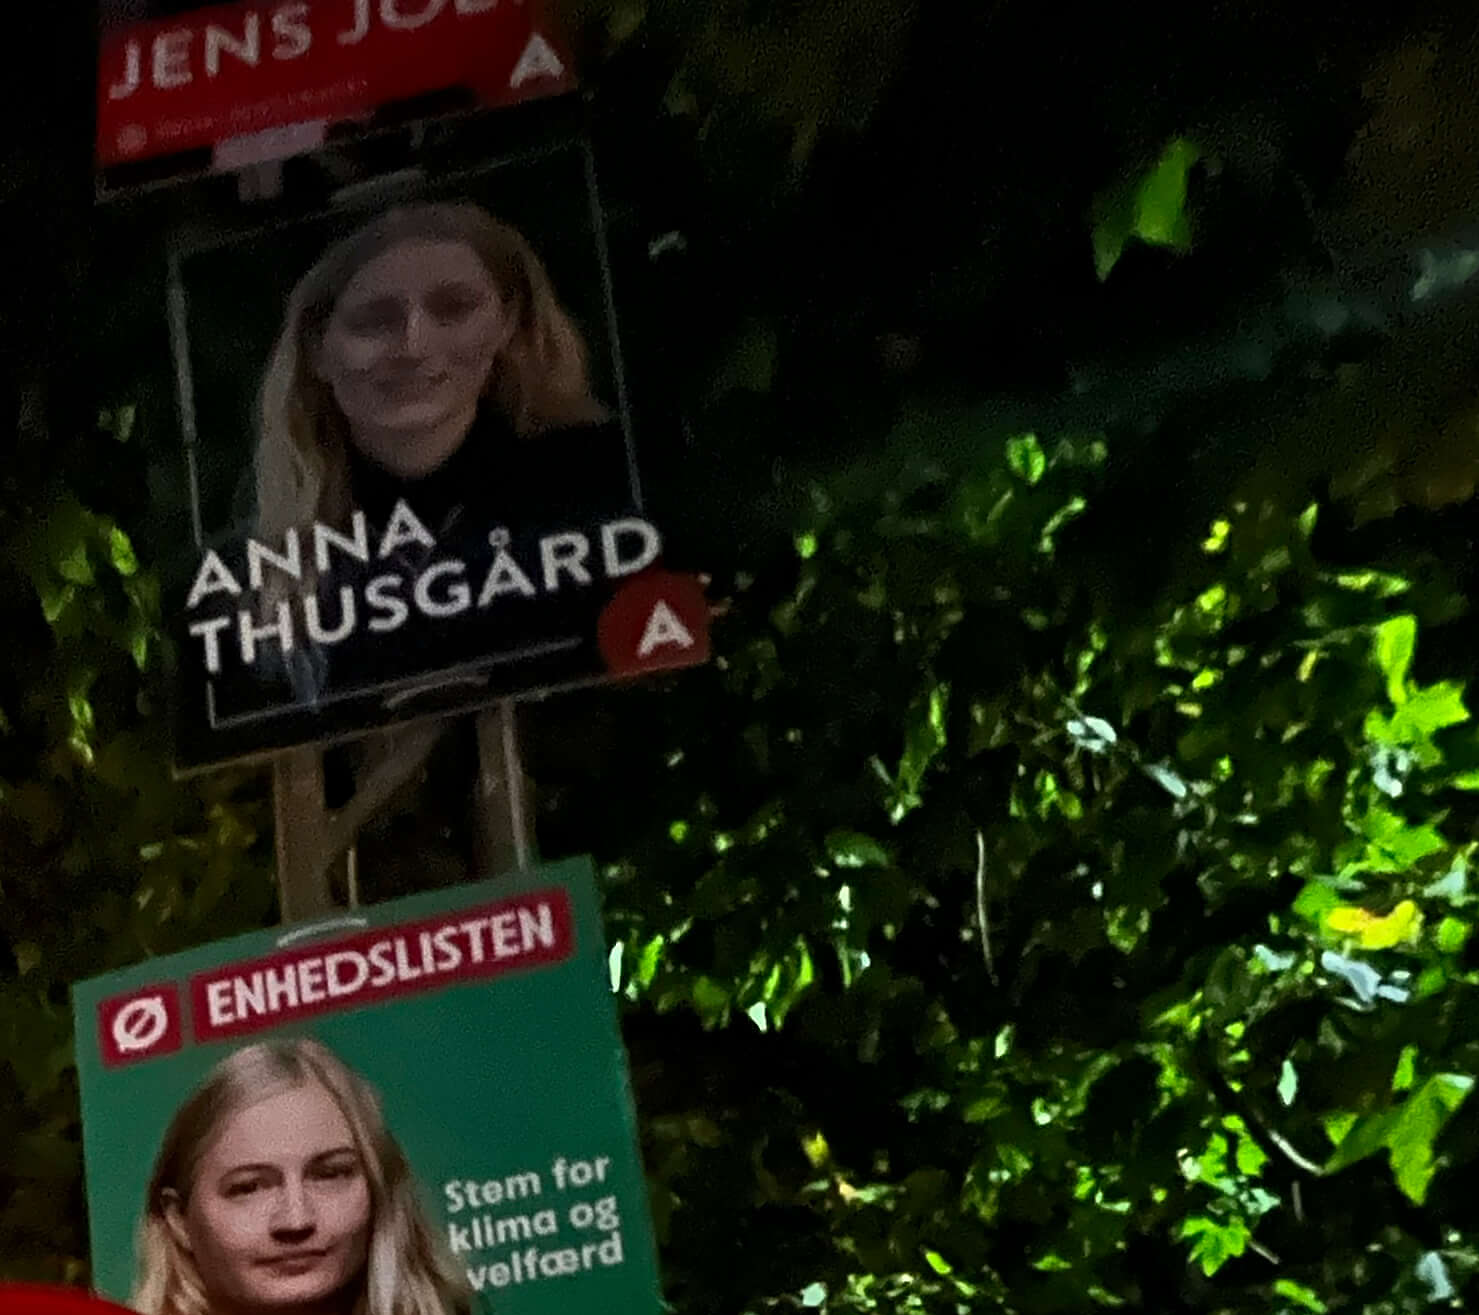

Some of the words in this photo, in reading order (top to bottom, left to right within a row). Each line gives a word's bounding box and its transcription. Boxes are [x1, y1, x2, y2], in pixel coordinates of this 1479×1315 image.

[108, 2, 313, 100] JENS
[509, 32, 565, 89] A
[186, 498, 436, 609] ANNA
[189, 517, 661, 673] THUSGÅRD
[638, 600, 694, 658] A
[206, 903, 555, 1027] ENHEDSLISTEN
[444, 1171, 541, 1214] Stem
[552, 1155, 610, 1190] for
[448, 1209, 558, 1255] klima
[569, 1195, 620, 1231] og
[466, 1230, 623, 1291] velfærd
